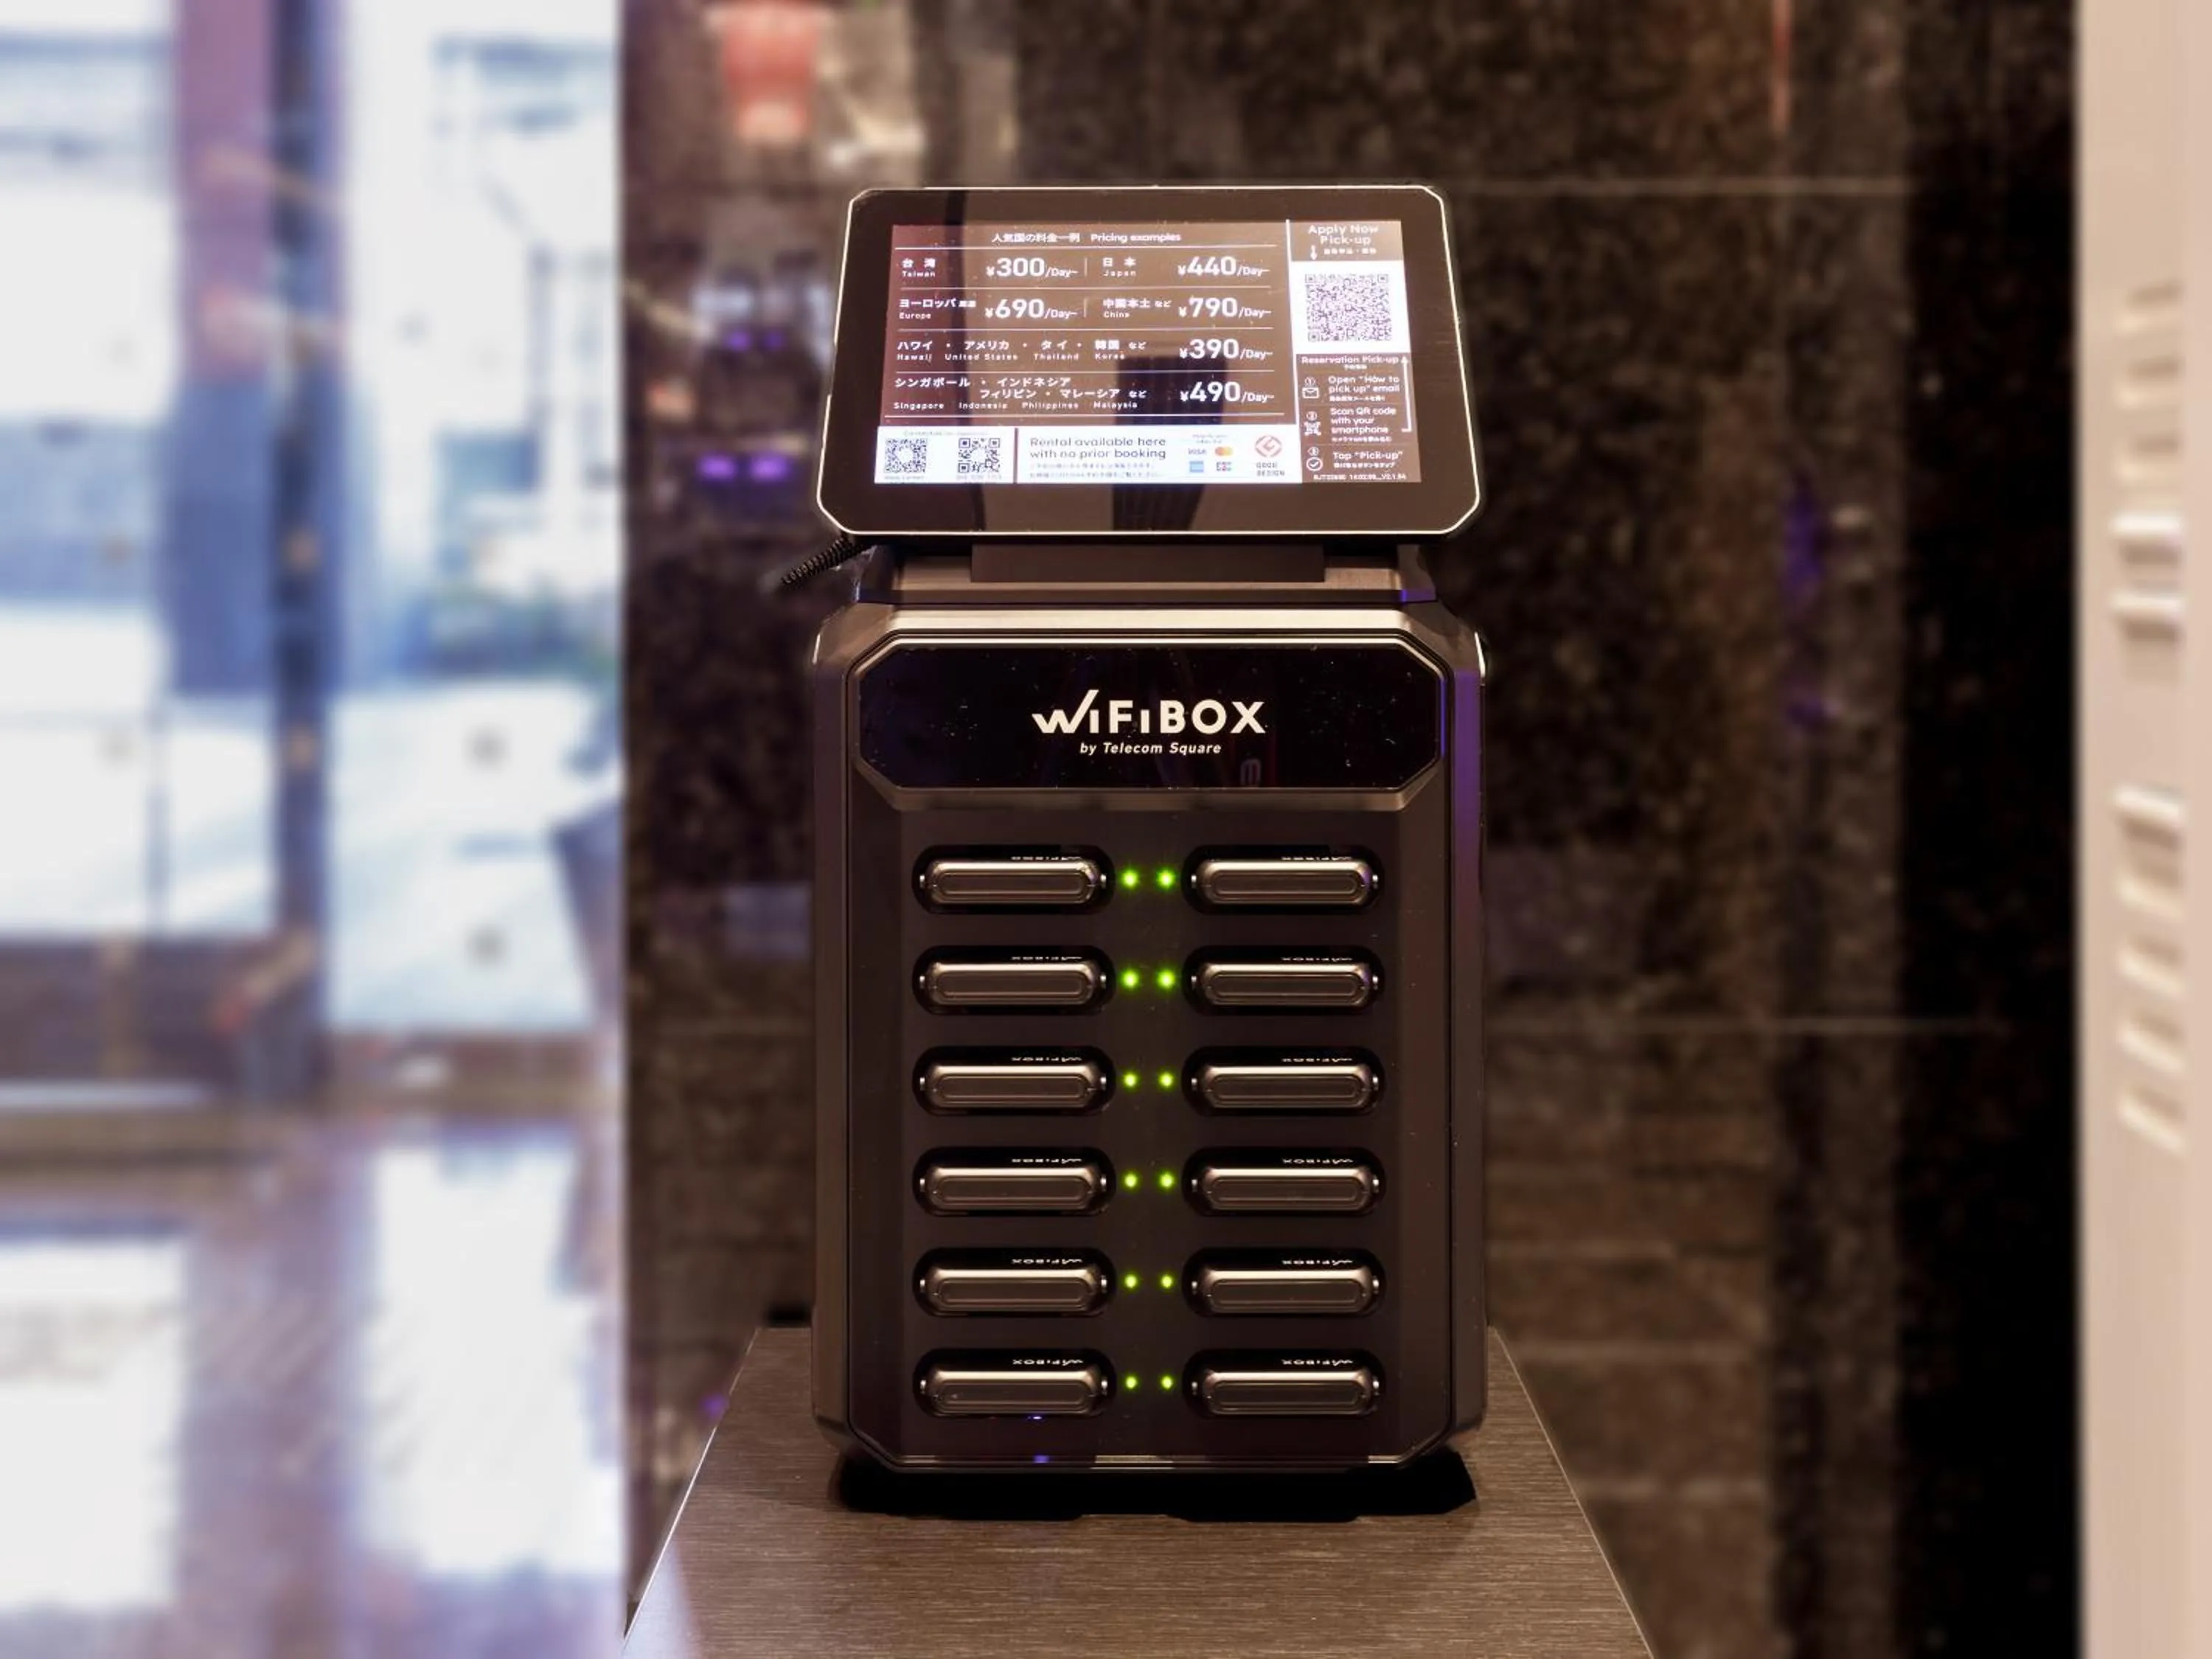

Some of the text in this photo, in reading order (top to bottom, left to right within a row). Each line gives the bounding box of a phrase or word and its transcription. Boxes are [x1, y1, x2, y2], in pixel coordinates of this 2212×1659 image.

[1308, 224, 1379, 235] Apply Now
[1091, 233, 1181, 243] Pricing examples
[1320, 235, 1371, 246] Pick-up
[899, 312, 932, 320] Europe
[1103, 310, 1130, 319] China
[1033, 352, 1079, 361] Thailand
[1301, 355, 1399, 365] Reservation Pick-up
[1328, 375, 1356, 385] Open
[1388, 375, 1400, 383] to
[1328, 384, 1352, 394] pick
[1372, 384, 1400, 393] email
[893, 402, 945, 410] Singapore
[1022, 402, 1079, 410] Philippines
[1093, 400, 1138, 410] Malaysia
[1330, 406, 1397, 416] Scan QR code
[1330, 417, 1375, 426] with your
[1331, 426, 1389, 436] smartphone
[1030, 437, 1166, 447] Rental available here
[1030, 449, 1057, 459] with
[1079, 448, 1110, 460] prior
[1114, 448, 1166, 461] booking
[1333, 451, 1352, 461] Tap
[1079, 742, 1222, 756] by Telecom Square
